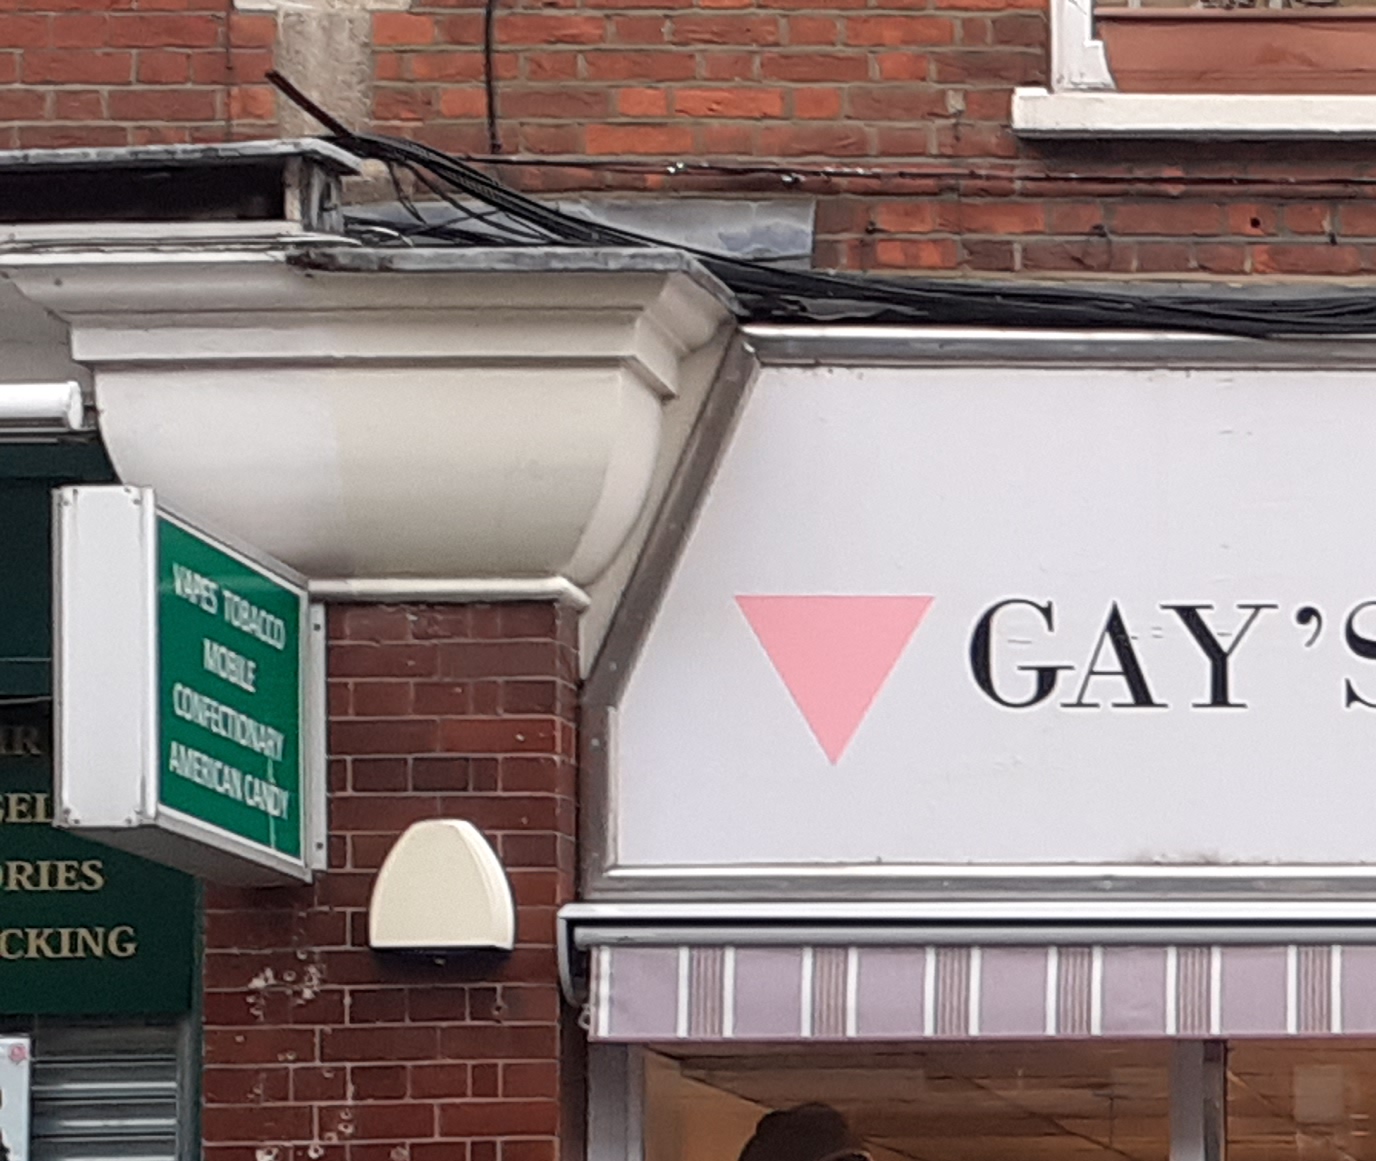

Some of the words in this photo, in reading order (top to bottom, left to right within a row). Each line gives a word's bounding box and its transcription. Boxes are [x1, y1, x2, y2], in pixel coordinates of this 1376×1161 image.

[172, 562, 218, 615] VAPES
[222, 587, 286, 650] TOBACCO
[203, 637, 256, 692] MOBILE
[169, 740, 242, 801] AMERICAN
[245, 773, 289, 820] CANDY
[0, 860, 104, 891] RIES
